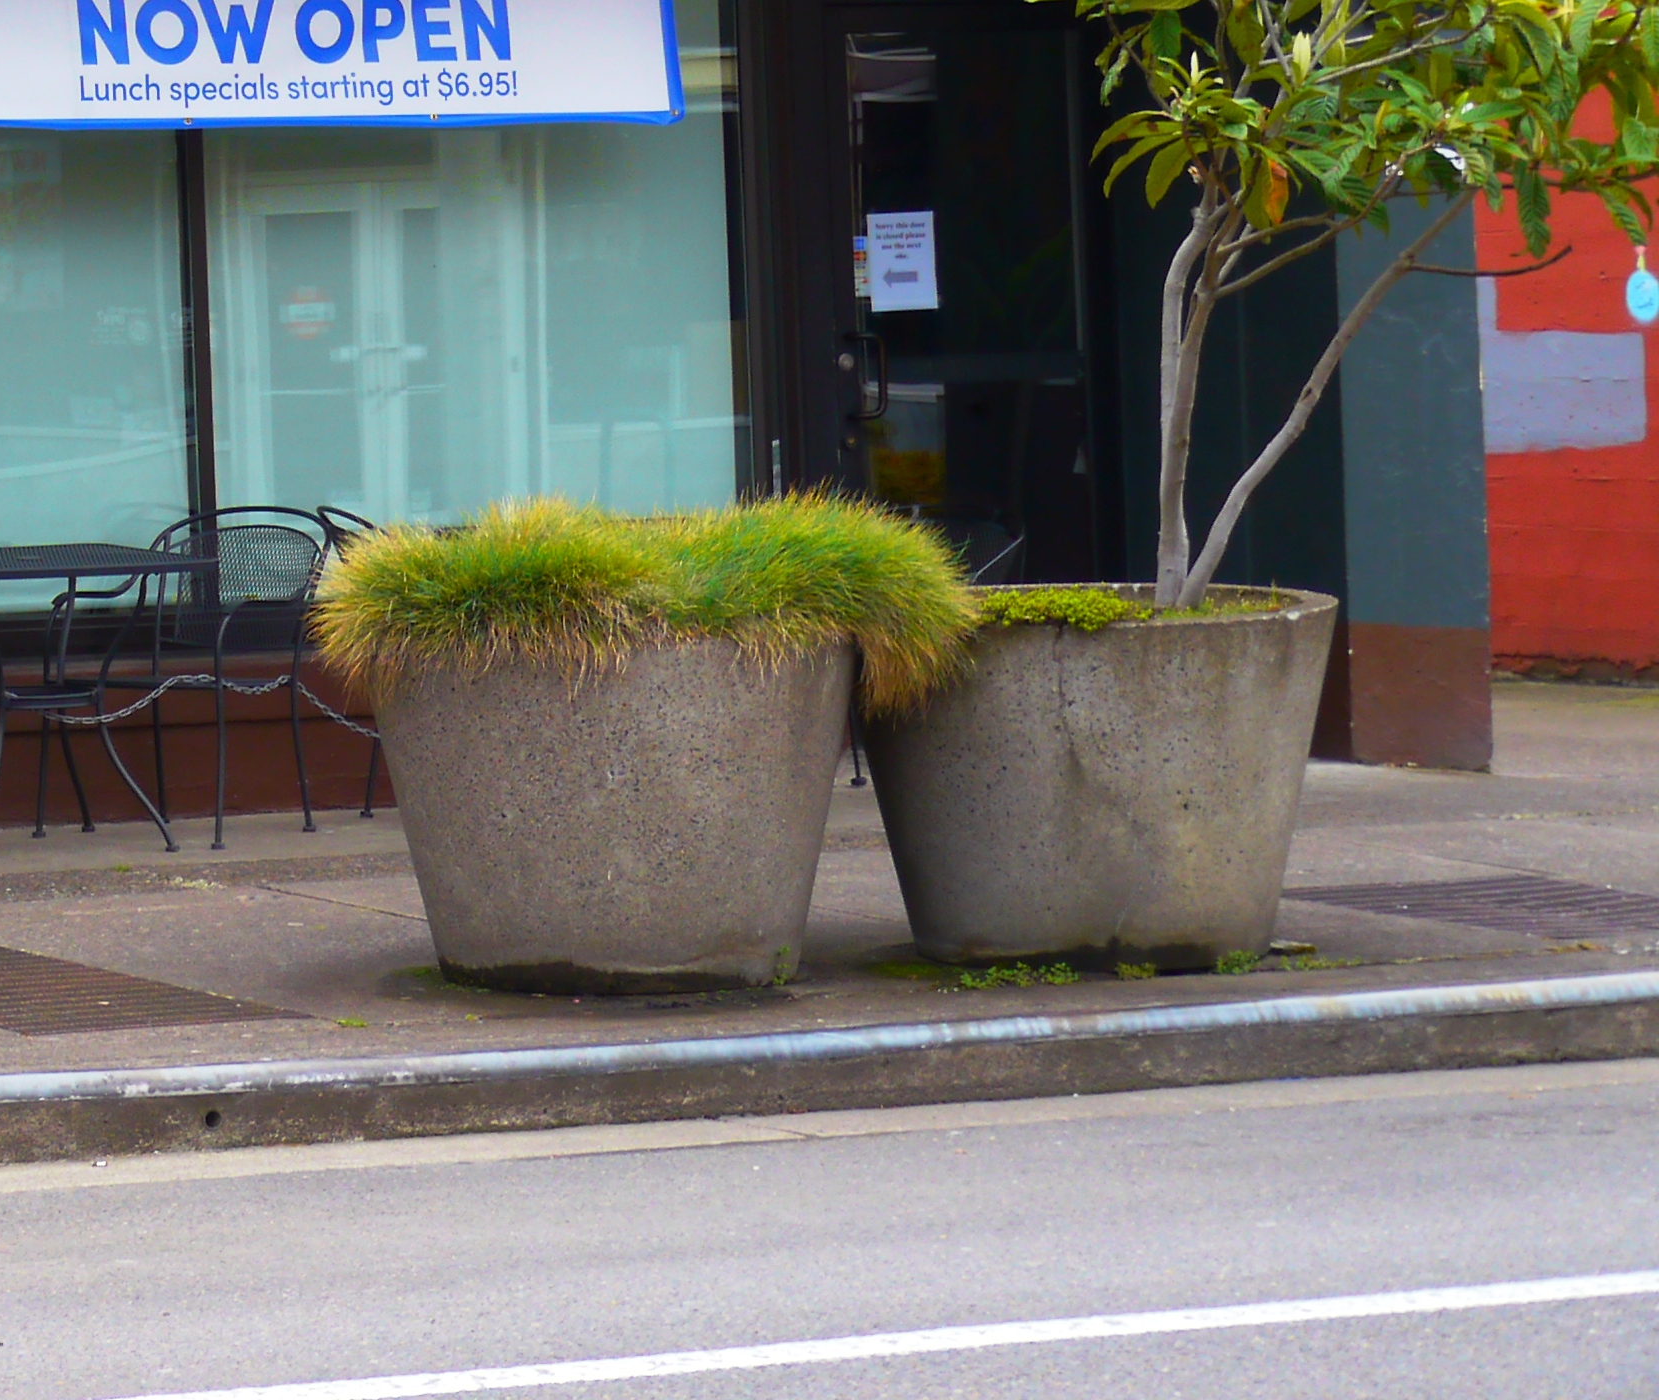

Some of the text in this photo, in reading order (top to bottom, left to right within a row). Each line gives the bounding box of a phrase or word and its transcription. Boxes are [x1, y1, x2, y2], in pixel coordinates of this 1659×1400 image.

[79, 70, 519, 108] Lunch specials starting at $6.95!
